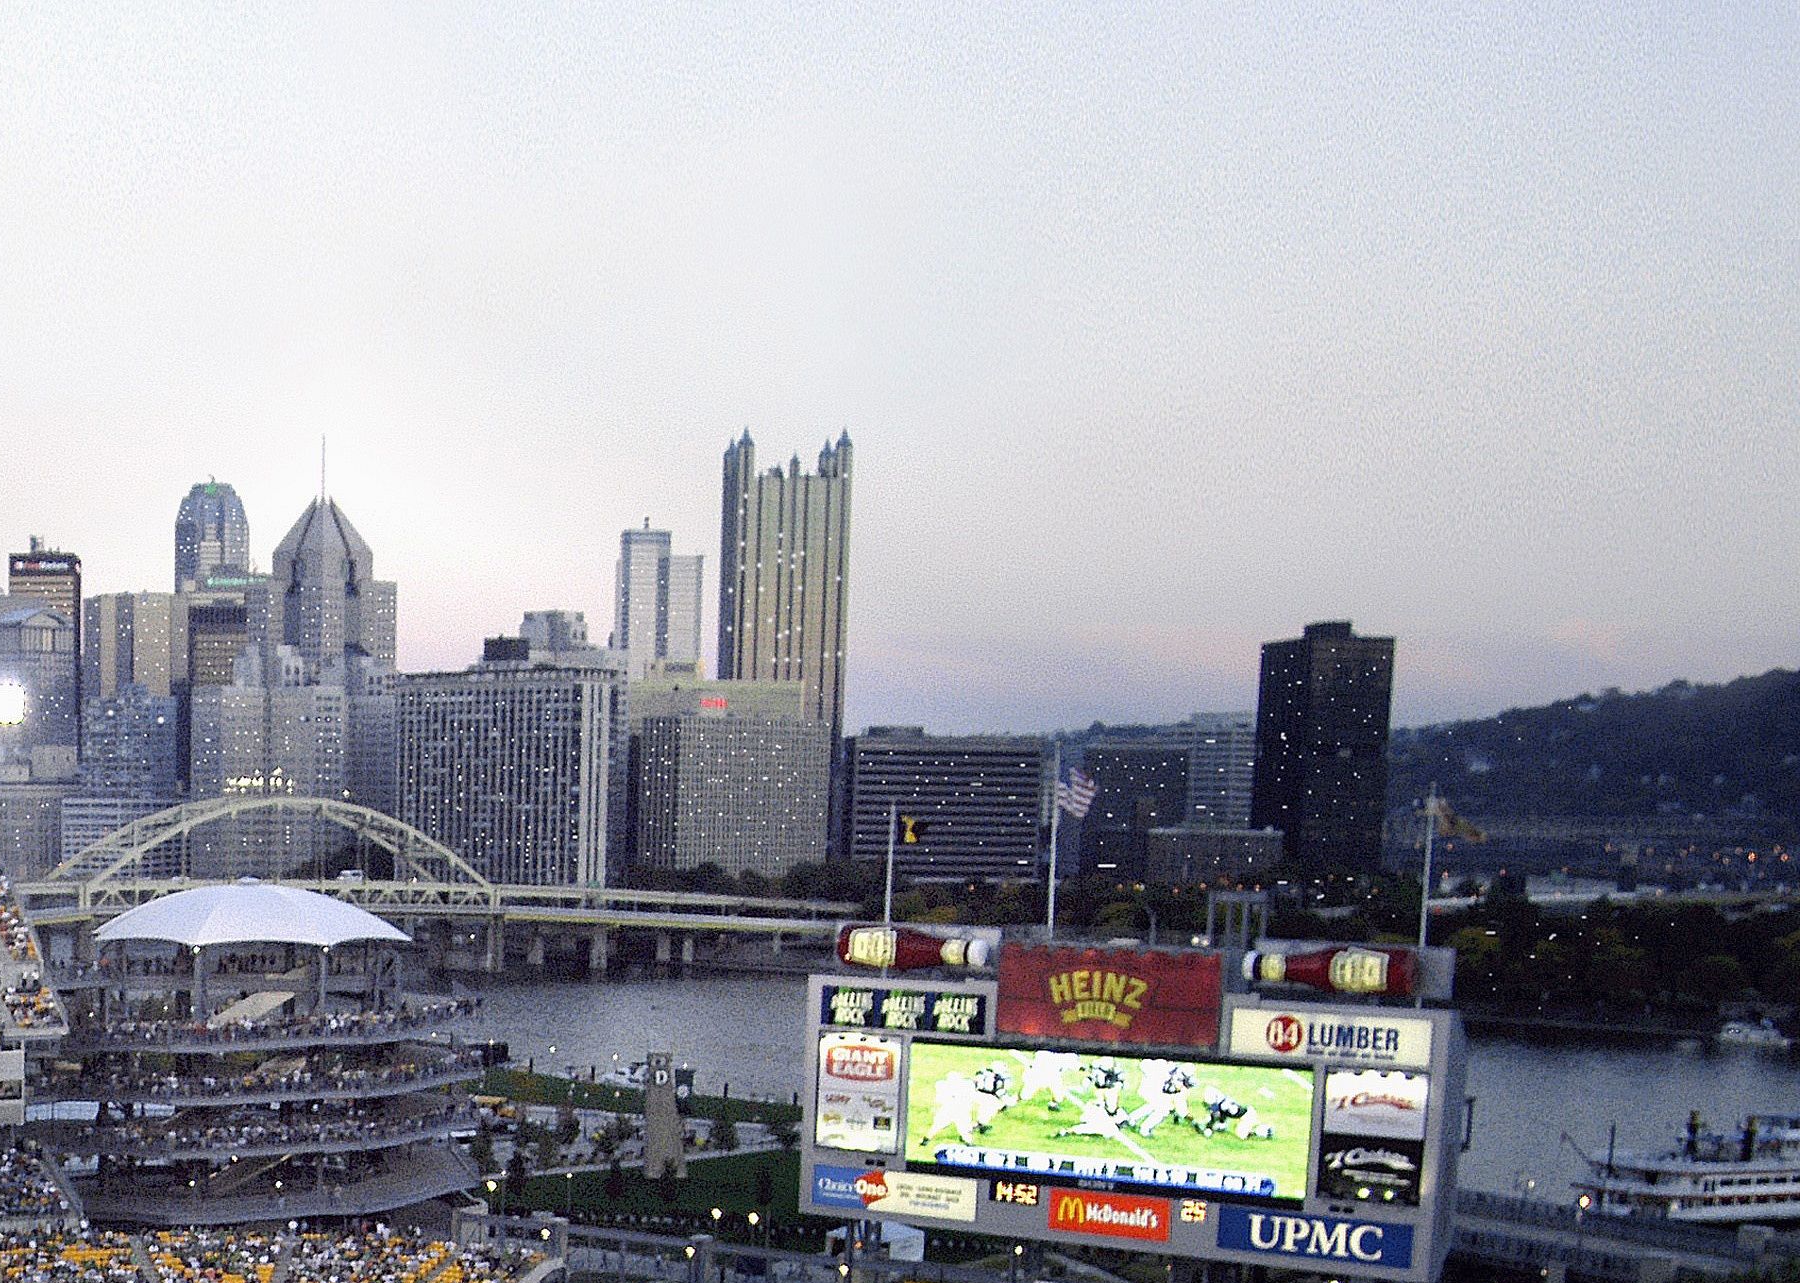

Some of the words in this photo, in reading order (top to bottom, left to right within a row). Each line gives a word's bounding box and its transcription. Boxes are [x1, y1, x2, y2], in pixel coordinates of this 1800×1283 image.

[1050, 969, 1148, 1010] HEINZ
[1268, 1019, 1300, 1047] 84
[1308, 1023, 1399, 1051] LUMBER
[831, 1049, 889, 1063] GIANT
[855, 1179, 887, 1196] One
[1086, 1204, 1158, 1229] McDonald's
[1249, 1213, 1383, 1261] UPMC
